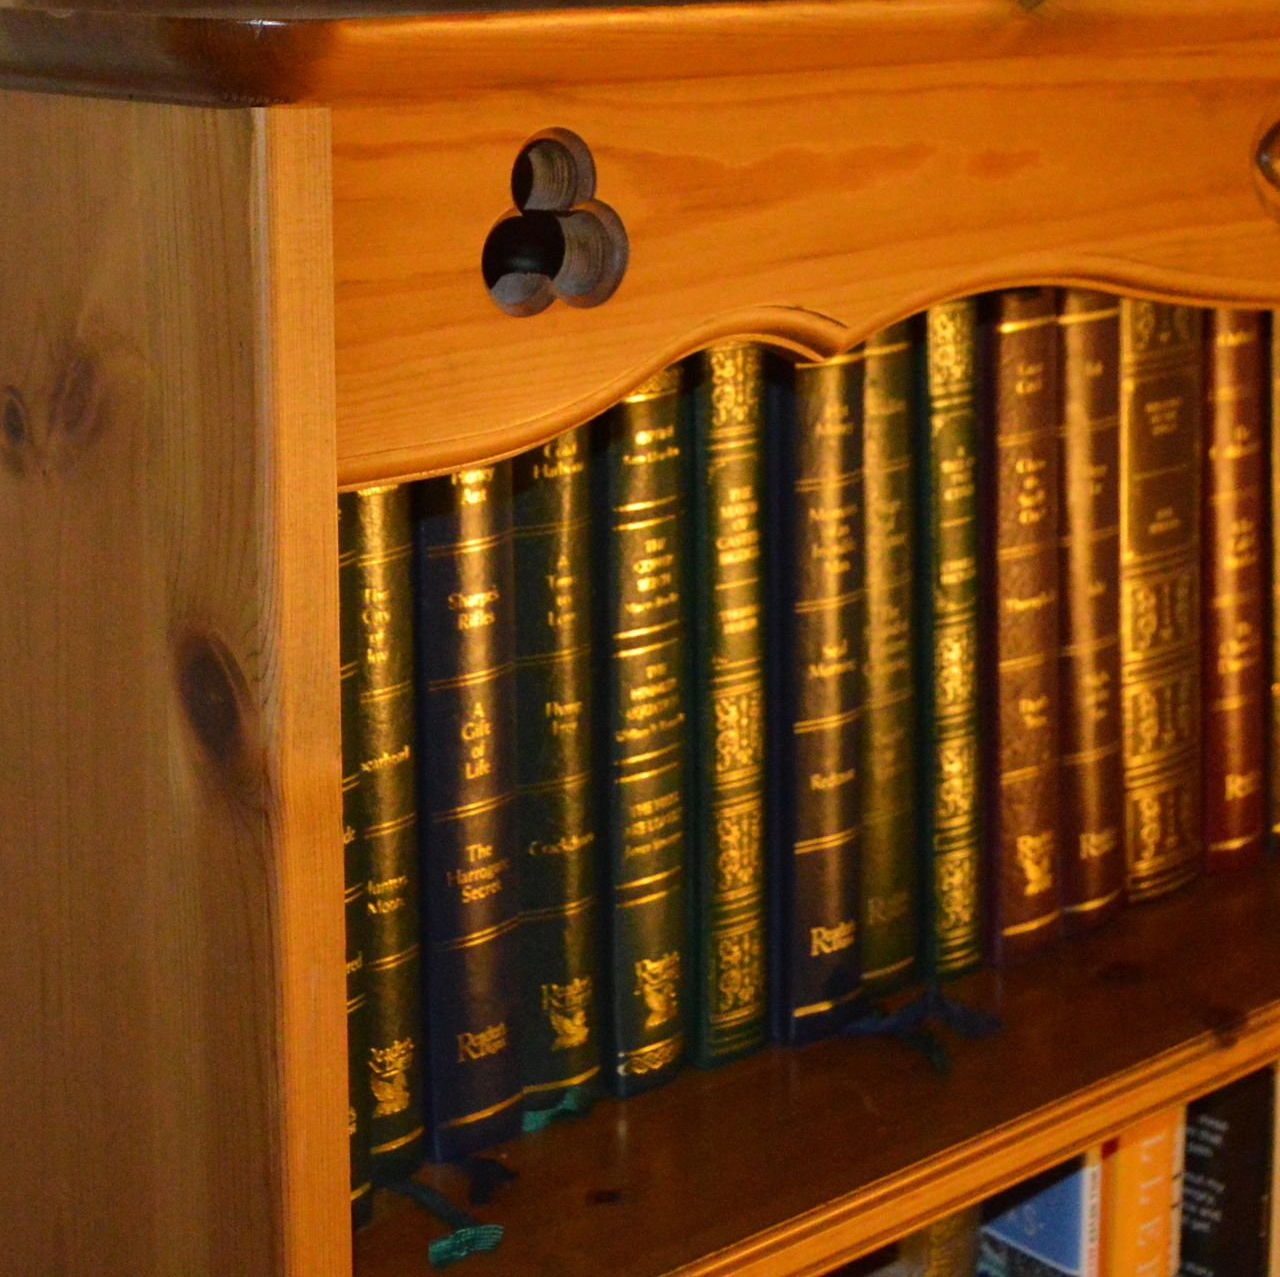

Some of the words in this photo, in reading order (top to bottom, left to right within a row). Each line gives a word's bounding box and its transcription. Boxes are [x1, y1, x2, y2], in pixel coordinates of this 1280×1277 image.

[473, 702, 486, 718] A
[461, 719, 492, 741] Gift
[471, 741, 487, 759] of
[466, 759, 492, 779] Life
[466, 843, 494, 862] The
[462, 880, 503, 903] Secret
